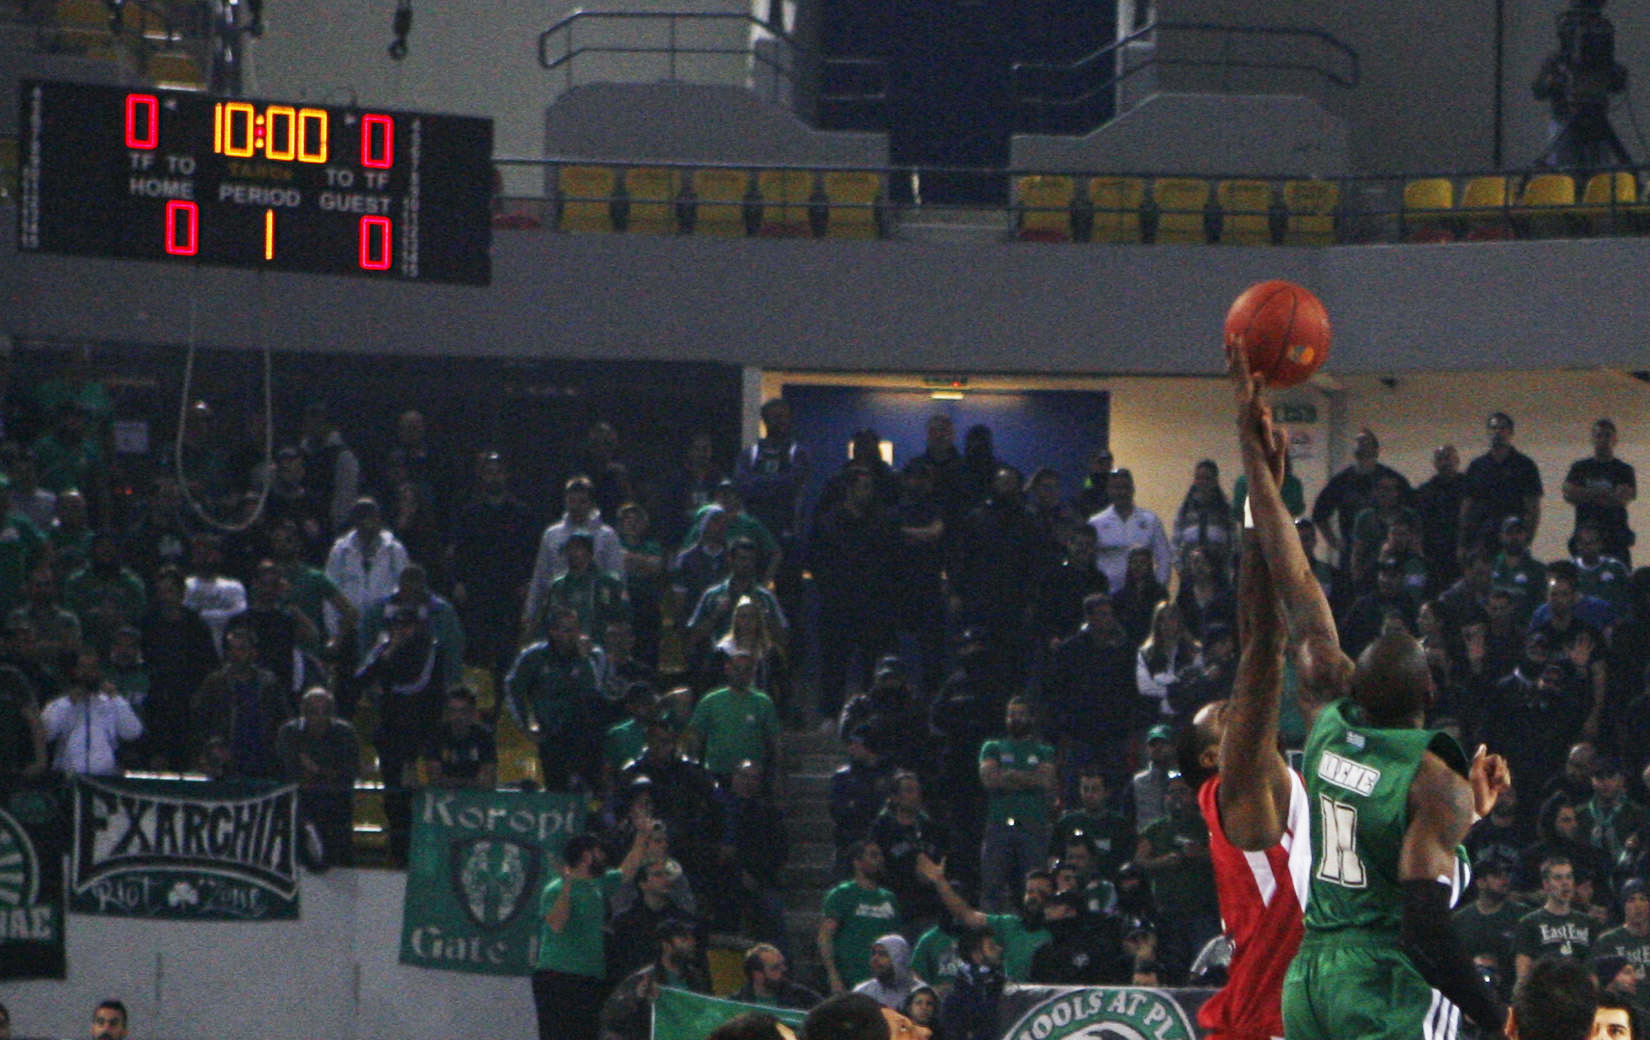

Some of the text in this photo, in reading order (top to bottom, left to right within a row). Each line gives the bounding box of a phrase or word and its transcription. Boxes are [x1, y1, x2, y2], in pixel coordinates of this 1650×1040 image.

[125, 93, 159, 149] 0
[213, 102, 328, 163] 10:00
[360, 113, 394, 169] 0
[129, 153, 196, 176] TF TO
[129, 177, 195, 199] HOME
[325, 168, 391, 190] TO TF
[218, 184, 301, 207] PERIOD
[319, 192, 391, 214] GUEST
[164, 199, 198, 256] 0
[265, 208, 274, 260] 1
[359, 215, 392, 270] 0
[422, 791, 575, 841] Koropi
[1107, 990, 1147, 1017] AT
